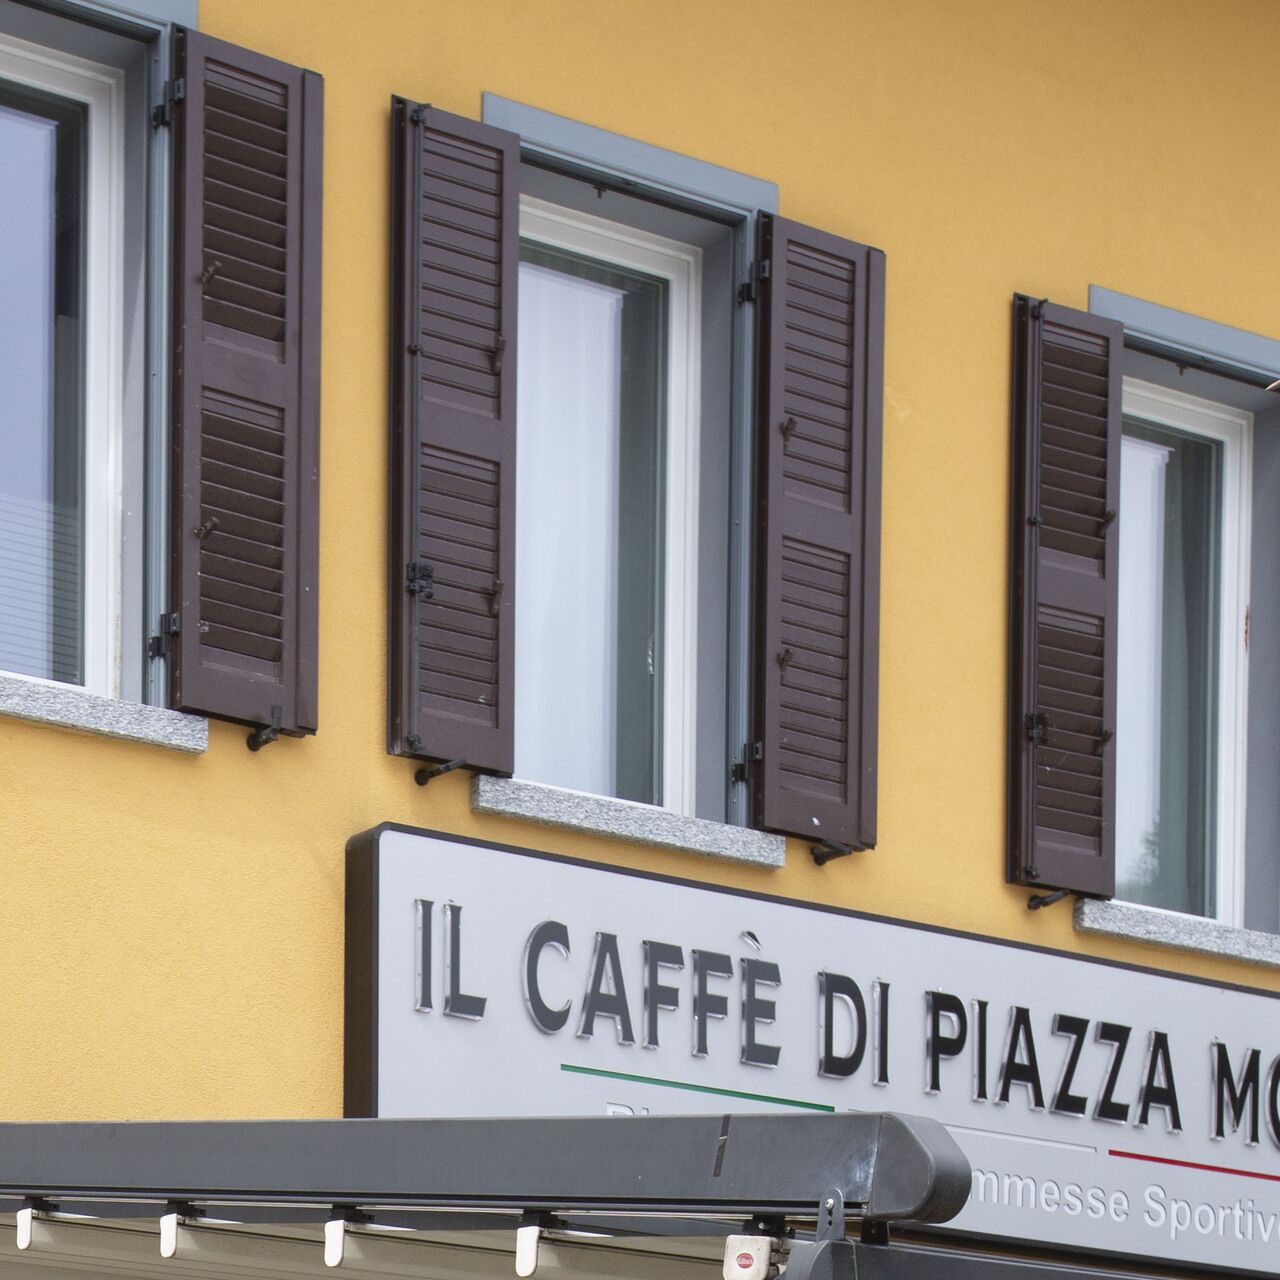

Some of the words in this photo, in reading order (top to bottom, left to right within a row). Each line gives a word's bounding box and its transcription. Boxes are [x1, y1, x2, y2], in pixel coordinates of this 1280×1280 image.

[414, 898, 487, 1020] IL
[521, 919, 782, 1069] CAFFÈ
[817, 967, 892, 1087] DI
[924, 986, 1183, 1135] PIAZZA
[1210, 1035, 1280, 1153] M
[1143, 1183, 1280, 1243] Sportiv
